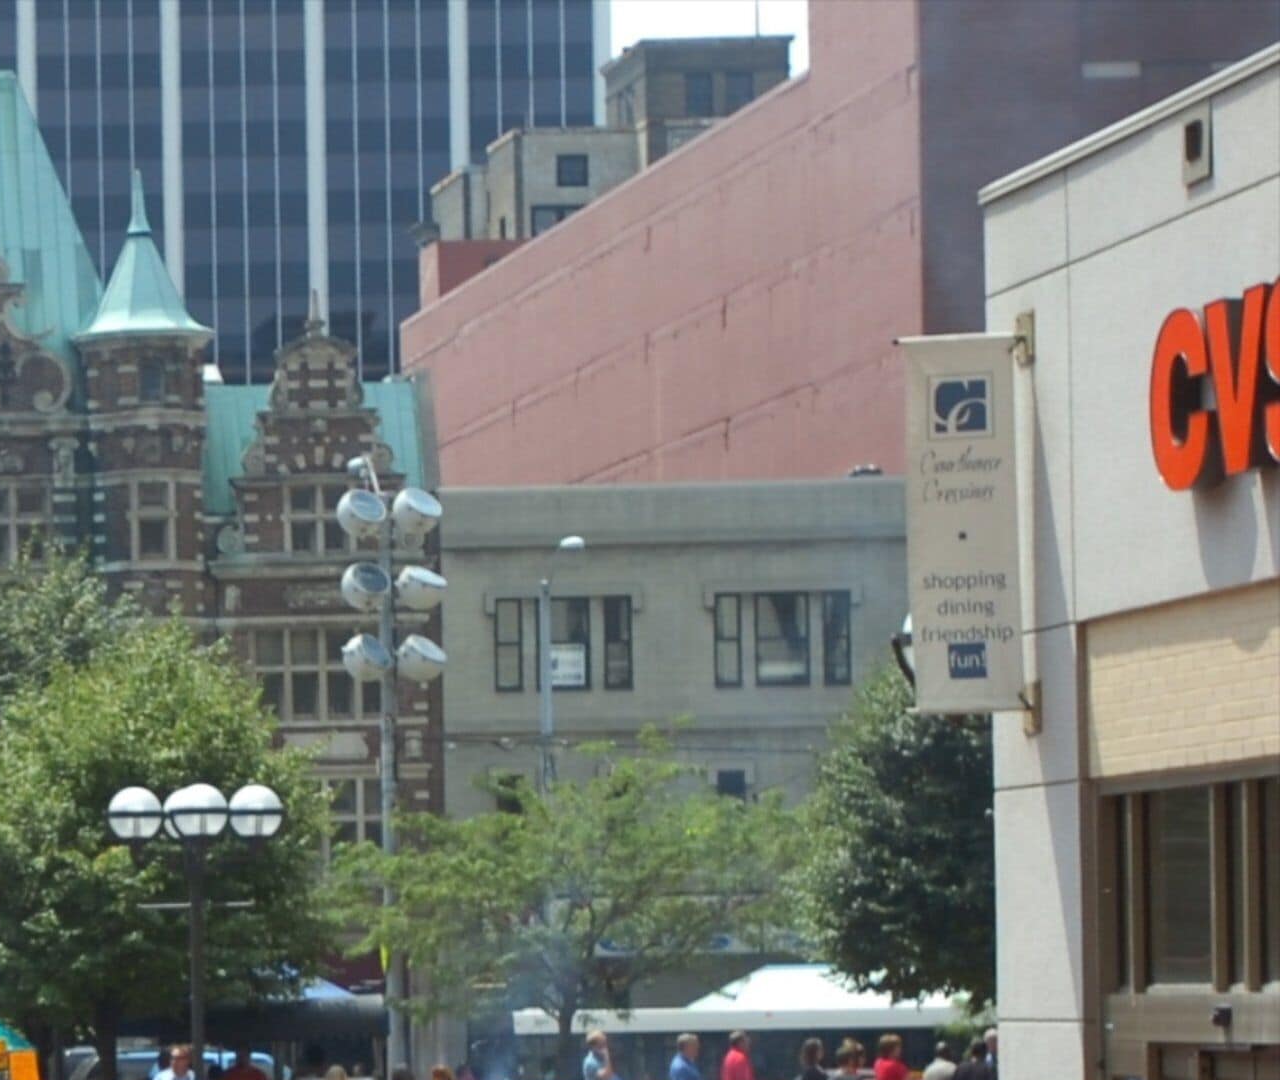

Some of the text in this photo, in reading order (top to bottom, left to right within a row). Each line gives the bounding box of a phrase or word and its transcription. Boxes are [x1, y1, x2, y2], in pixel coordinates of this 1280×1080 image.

[923, 570, 1007, 592] shopping
[937, 598, 995, 618] dining
[921, 624, 1014, 643] friendship
[951, 650, 986, 669] fun!
